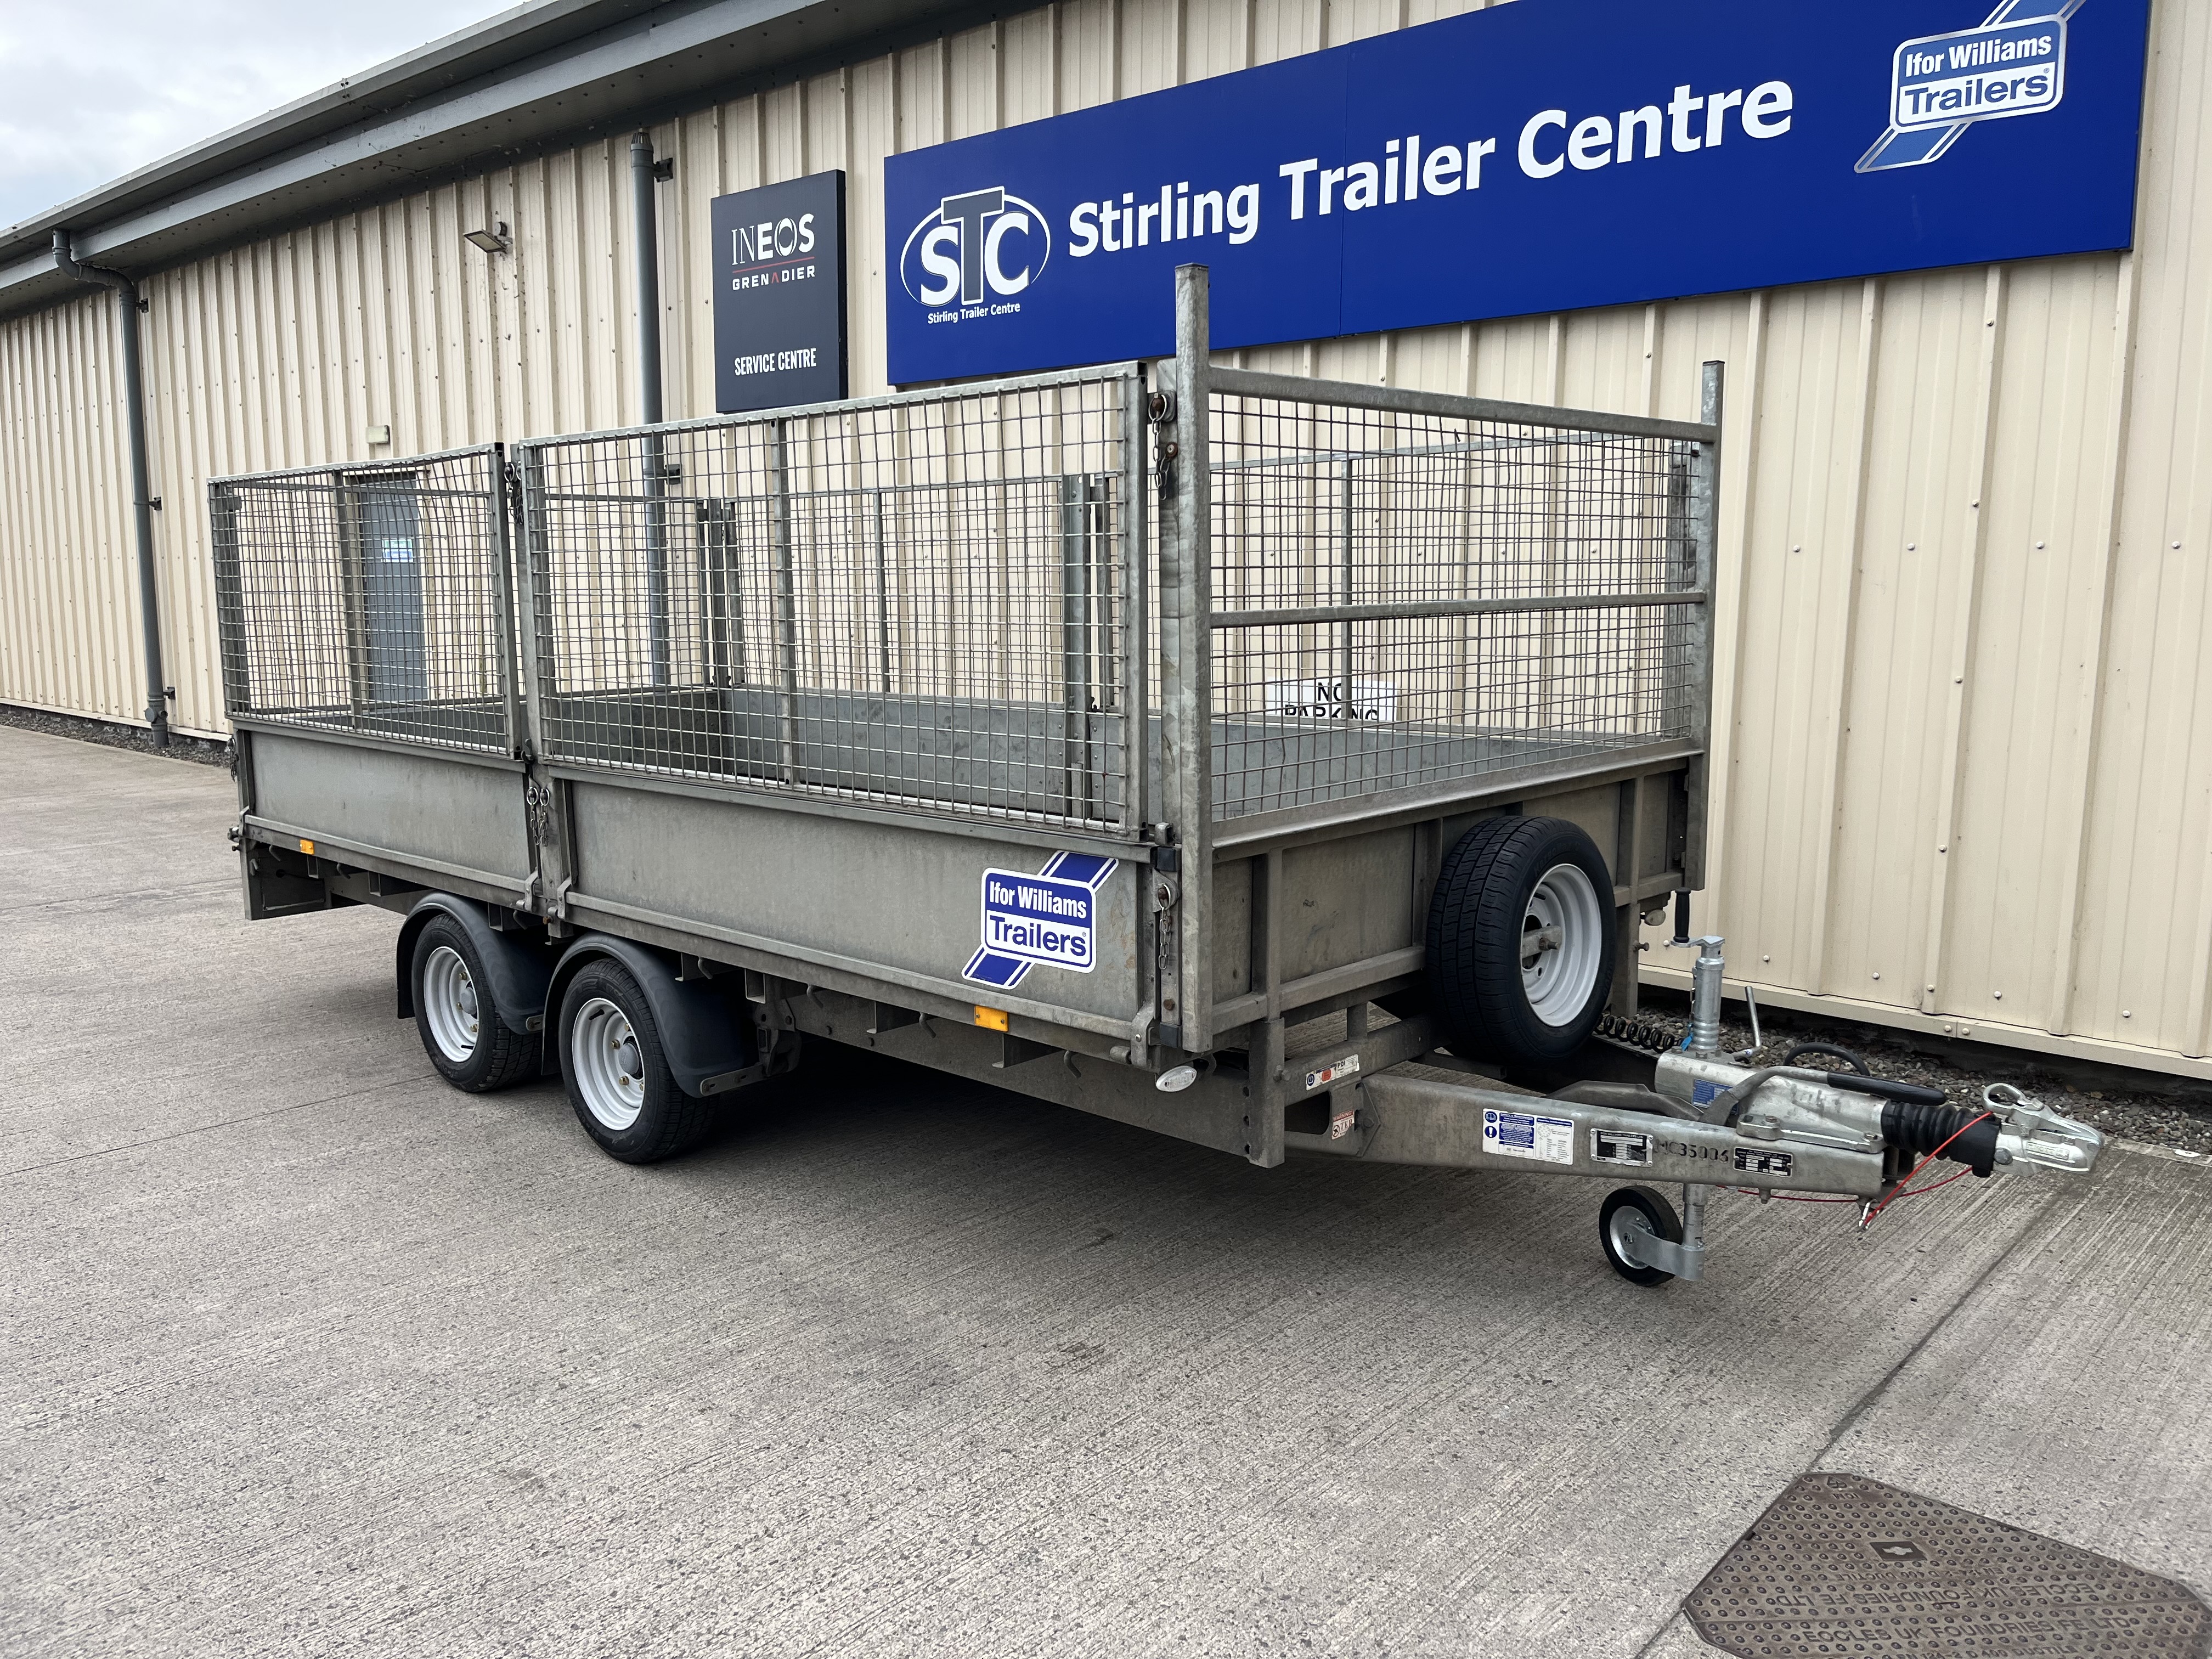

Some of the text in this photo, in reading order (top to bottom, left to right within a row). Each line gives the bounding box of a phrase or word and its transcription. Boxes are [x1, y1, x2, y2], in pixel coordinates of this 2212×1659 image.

[1905, 36, 2052, 77] Ifor Williams
[1904, 74, 2048, 115] Trailers
[1069, 81, 1793, 258] Stirling Trailer Centre
[731, 212, 815, 266] INEOS
[919, 185, 1030, 307] STC
[732, 265, 815, 291] GRENADIER
[927, 302, 1021, 325] Stirling Trailer Centre
[734, 347, 817, 376] SERVICE CENTRE
[990, 881, 1087, 919] Ifor Williams
[990, 915, 1087, 957] Trailers
[1776, 1594, 1815, 1607] LTD
[1818, 1594, 1849, 1605] FE
[1853, 1589, 1974, 1605] FOUNDRIES
[2010, 1584, 2095, 1597] ECCLES
[1803, 1617, 2131, 1643] ECCLES UK FOUNDRIES FE LTD
